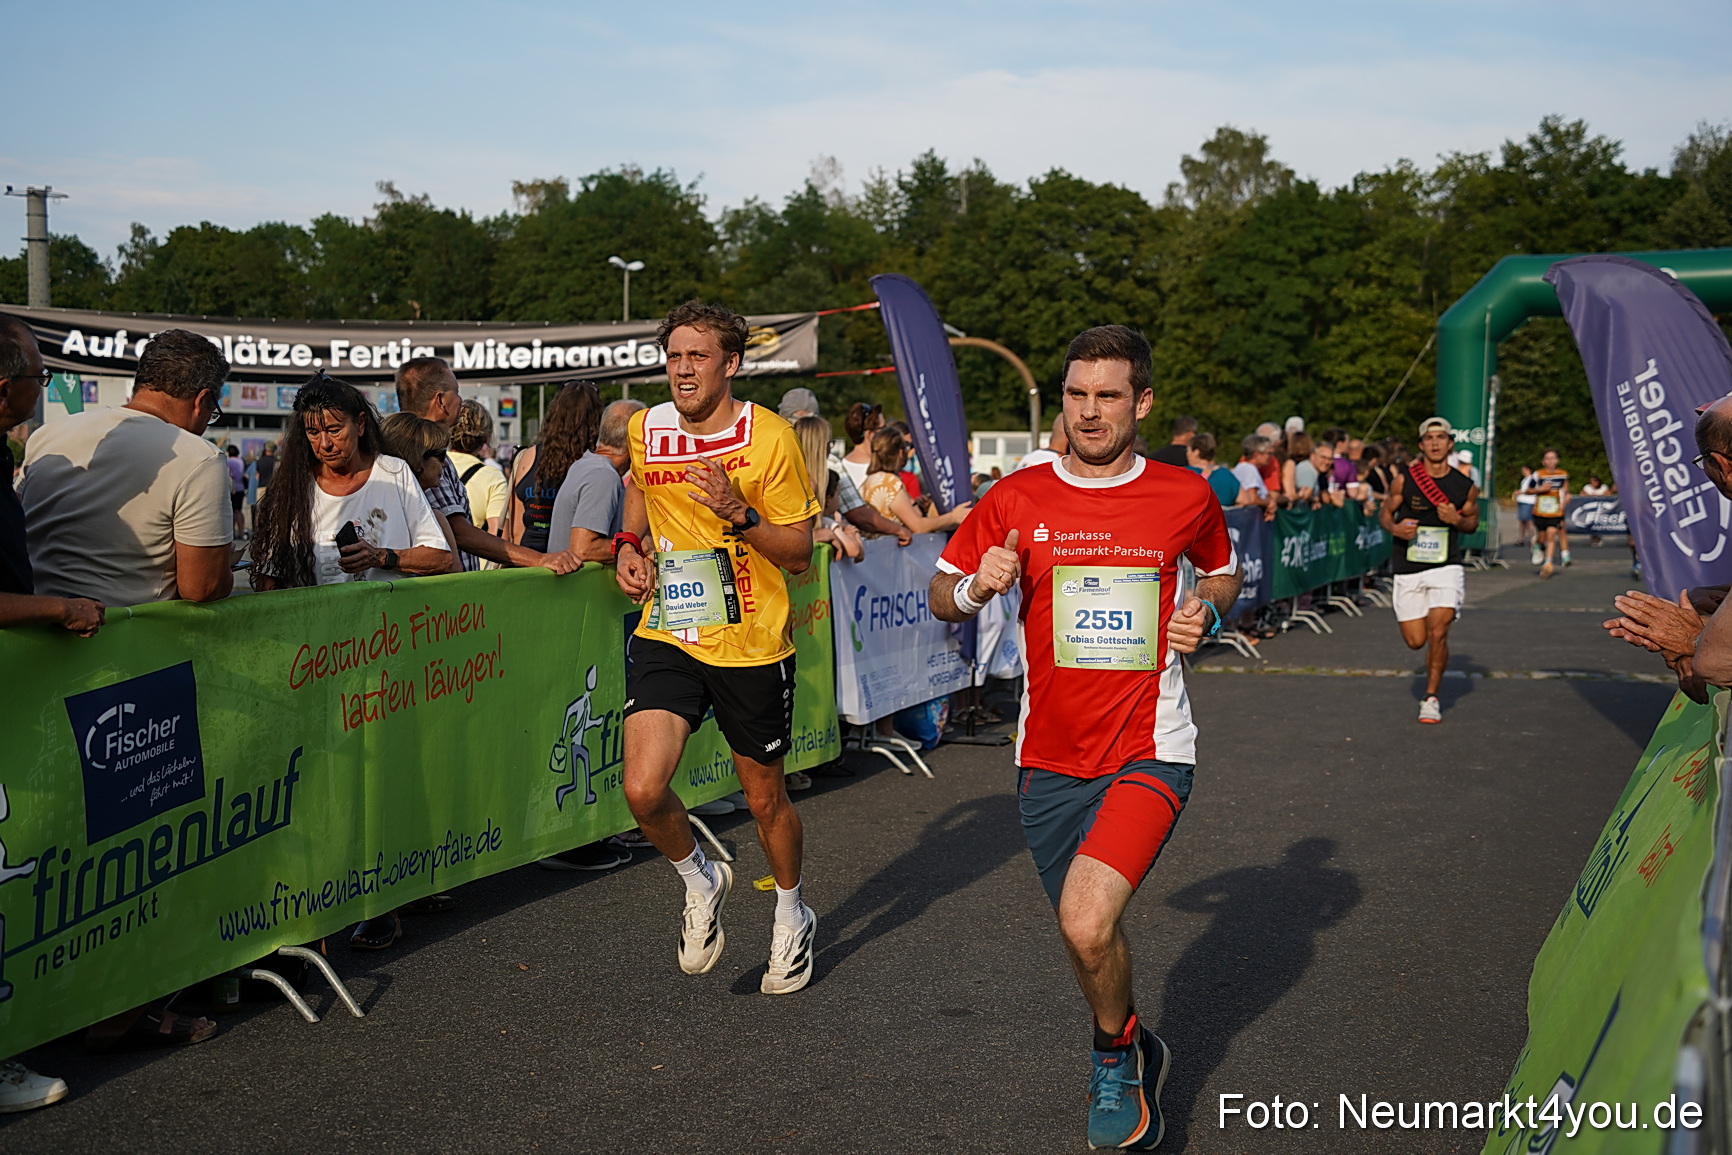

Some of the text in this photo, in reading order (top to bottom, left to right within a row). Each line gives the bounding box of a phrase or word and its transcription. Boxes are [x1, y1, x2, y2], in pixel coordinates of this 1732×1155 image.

[62, 329, 128, 358] Auf
[215, 334, 322, 368] lätze.
[1449, 429, 1470, 443] OK
[1053, 530, 1112, 542] Sparkasse
[1053, 545, 1164, 561] Neumarkt-Parsberg
[665, 601, 708, 611] David Weber
[869, 588, 933, 632] FRISCH
[1075, 610, 1132, 631] 2551
[290, 602, 486, 690] Gesunde Firmen
[1065, 635, 1146, 645] Tobias Gottschalk
[341, 633, 504, 732] laufen länger!
[105, 713, 181, 760] Fischer
[764, 738, 782, 753] JAKO
[114, 738, 176, 772] AUTOMOBILE
[33, 746, 303, 942] firmenlauf
[218, 818, 502, 942] www.firmenlauf-oberpfalz.de
[34, 891, 159, 980] neumarkt
